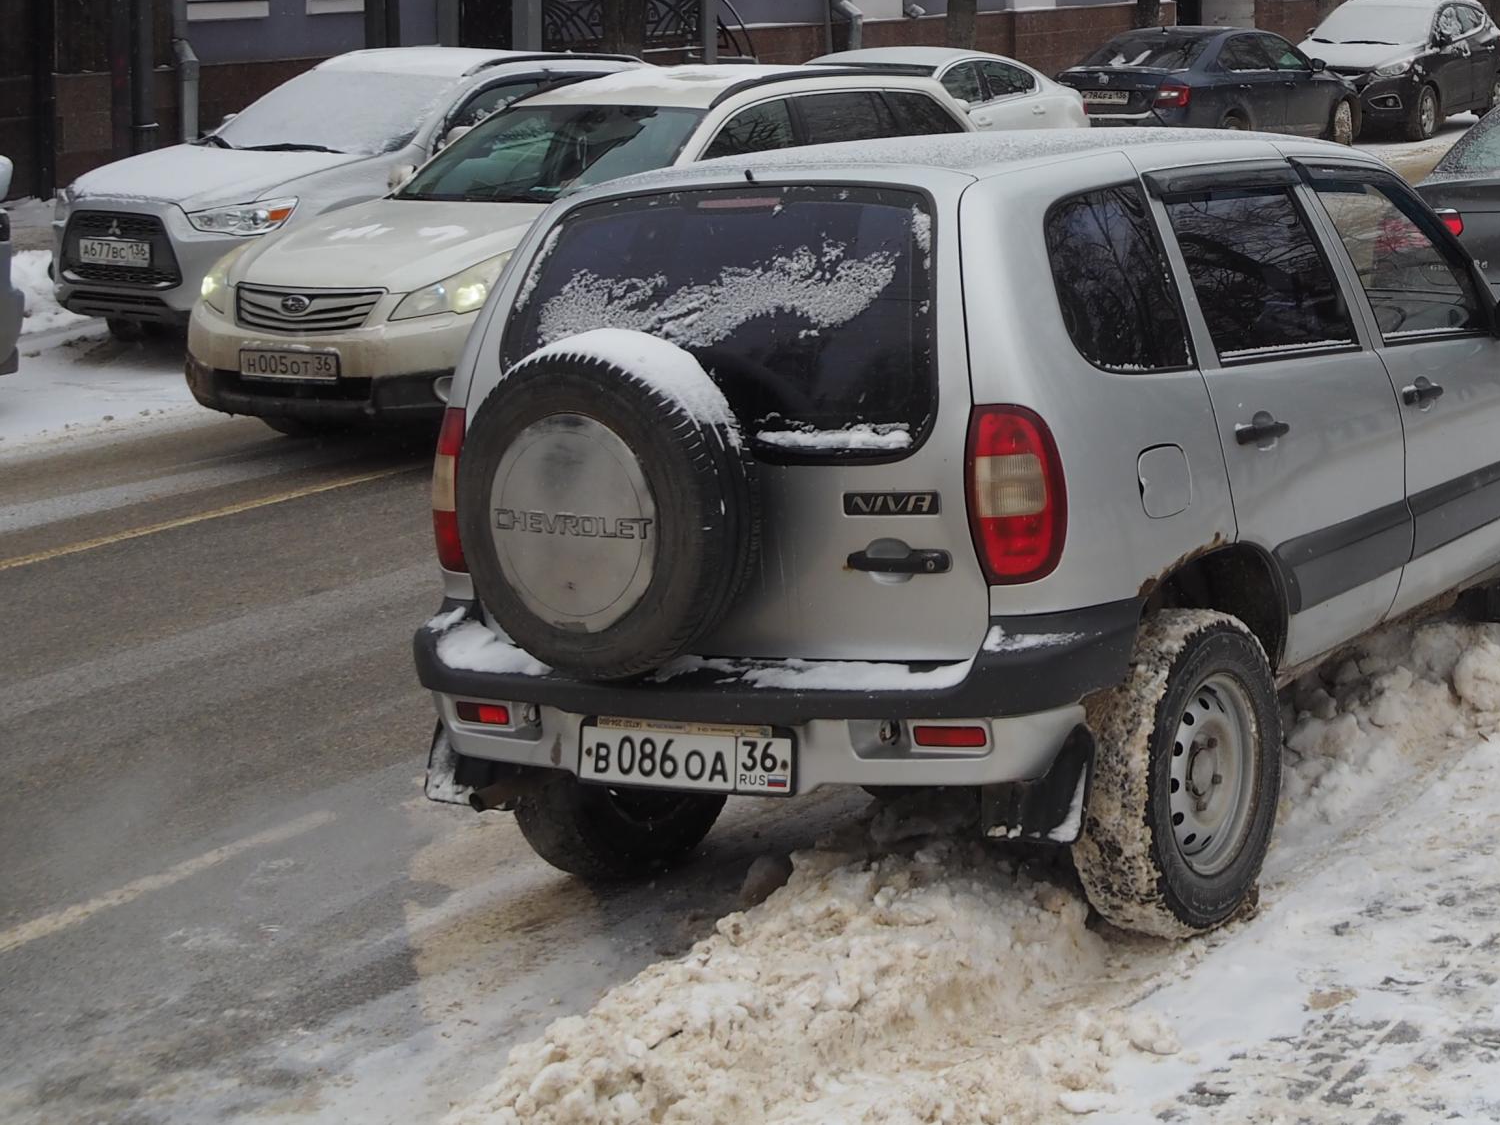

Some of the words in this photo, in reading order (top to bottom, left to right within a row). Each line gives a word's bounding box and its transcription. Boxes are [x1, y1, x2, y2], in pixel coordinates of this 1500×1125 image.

[247, 354, 310, 375] Н005ОТ
[314, 356, 332, 371] 36
[850, 494, 933, 513] NIVA
[494, 508, 653, 540] CHEVROLET
[741, 740, 779, 773] 36
[739, 773, 766, 787] RUS
